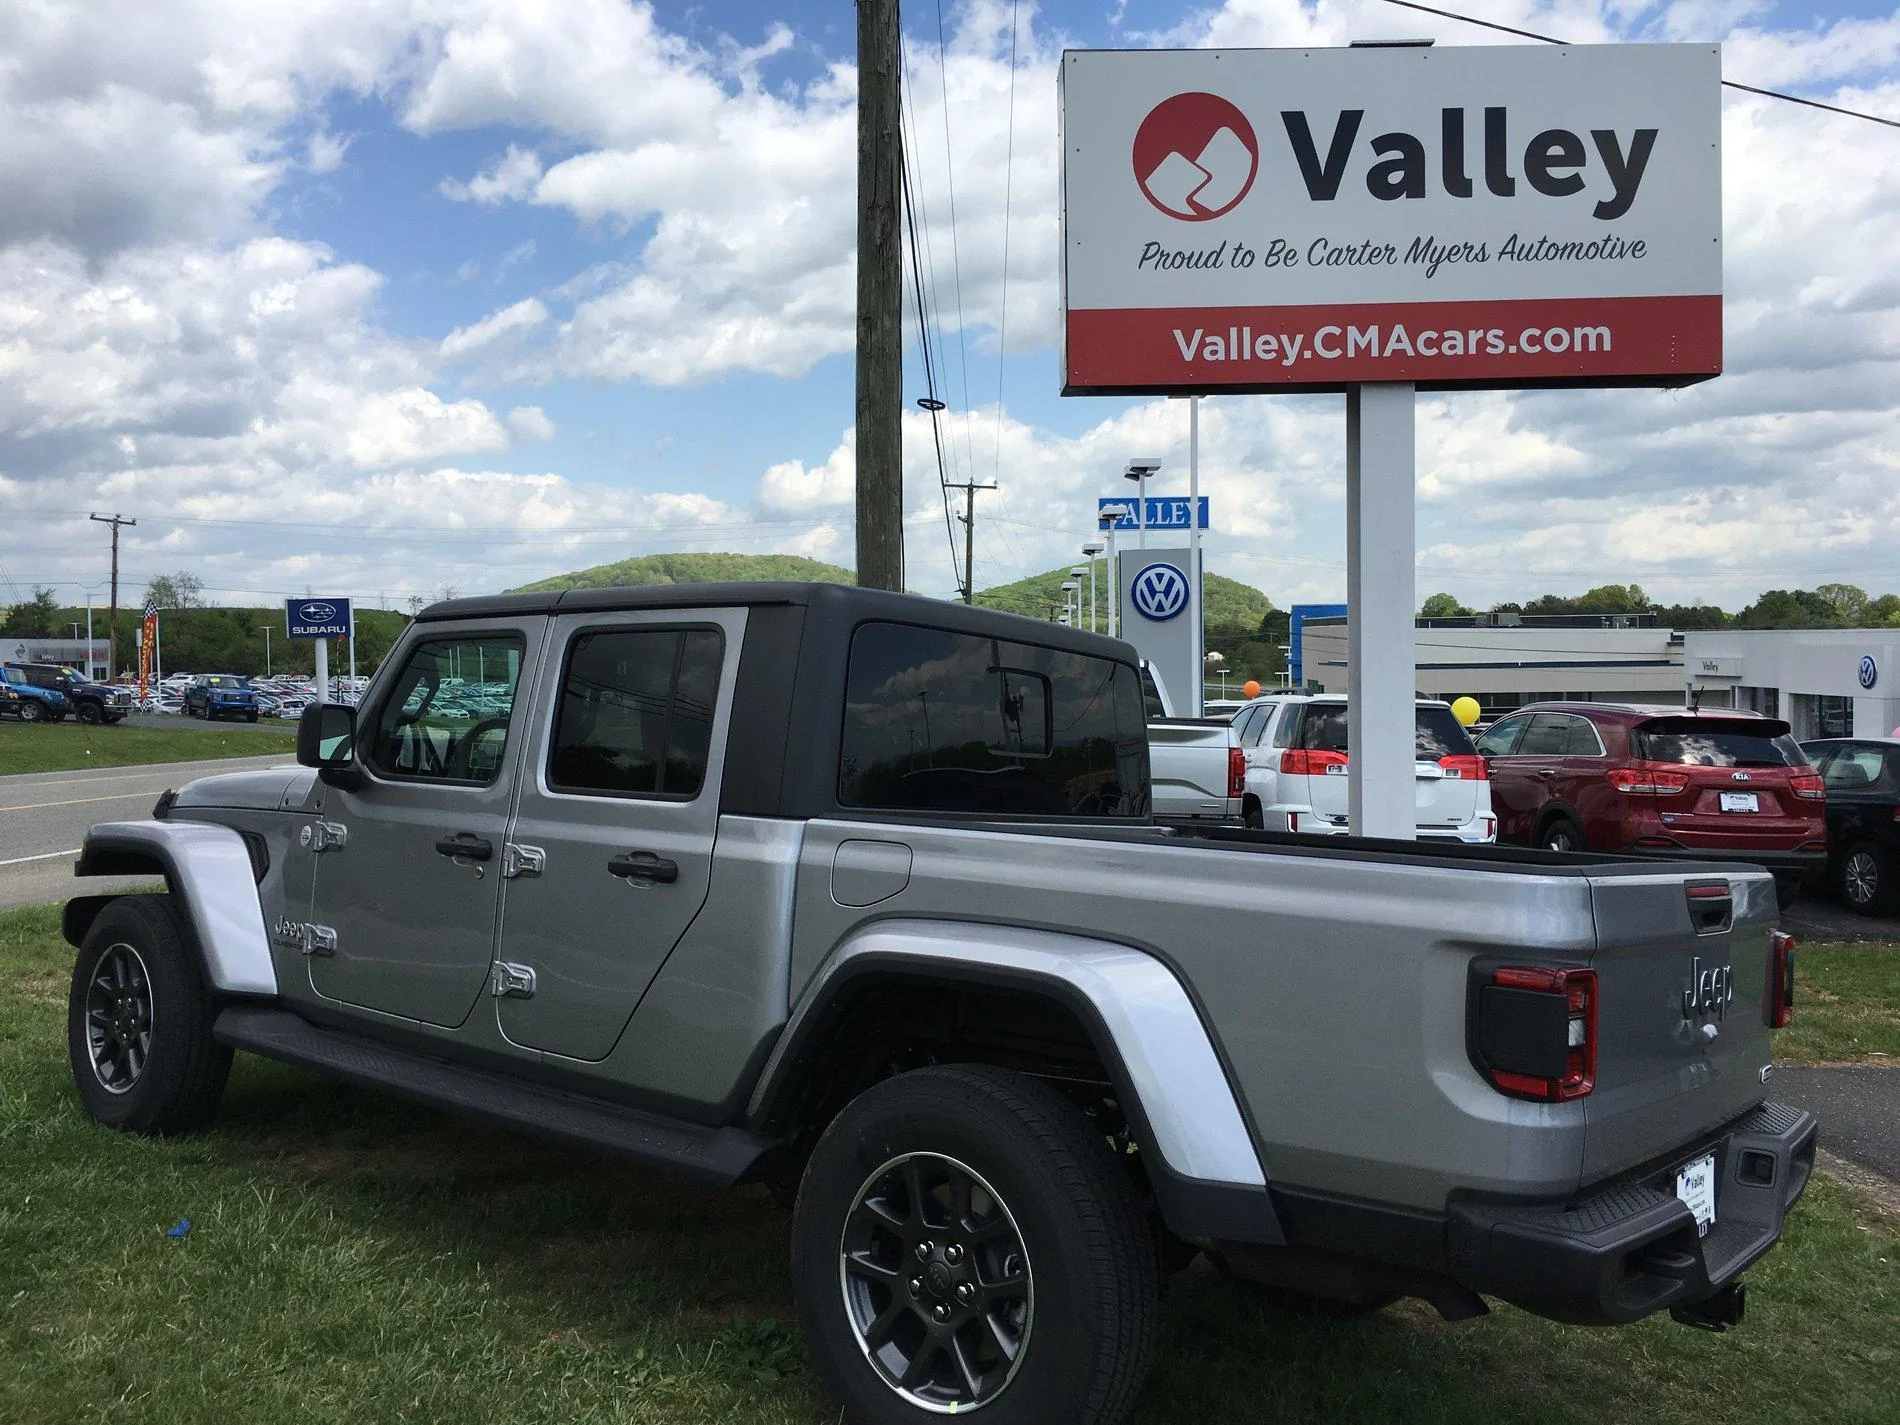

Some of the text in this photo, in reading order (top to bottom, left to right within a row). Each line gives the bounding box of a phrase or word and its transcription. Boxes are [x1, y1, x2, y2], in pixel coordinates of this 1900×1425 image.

[1279, 106, 1659, 221] Valley
[1138, 233, 1648, 279] Proud to Be Carter Myers Automotive
[1172, 324, 1612, 366] Valley.CMAcars.com
[1105, 502, 1202, 525] ALLE
[292, 626, 346, 634] SUBARU
[1702, 660, 1719, 672] Valley
[1733, 773, 1751, 781] KIA
[275, 914, 305, 941] Jeep
[1684, 956, 1733, 1022] Jeep
